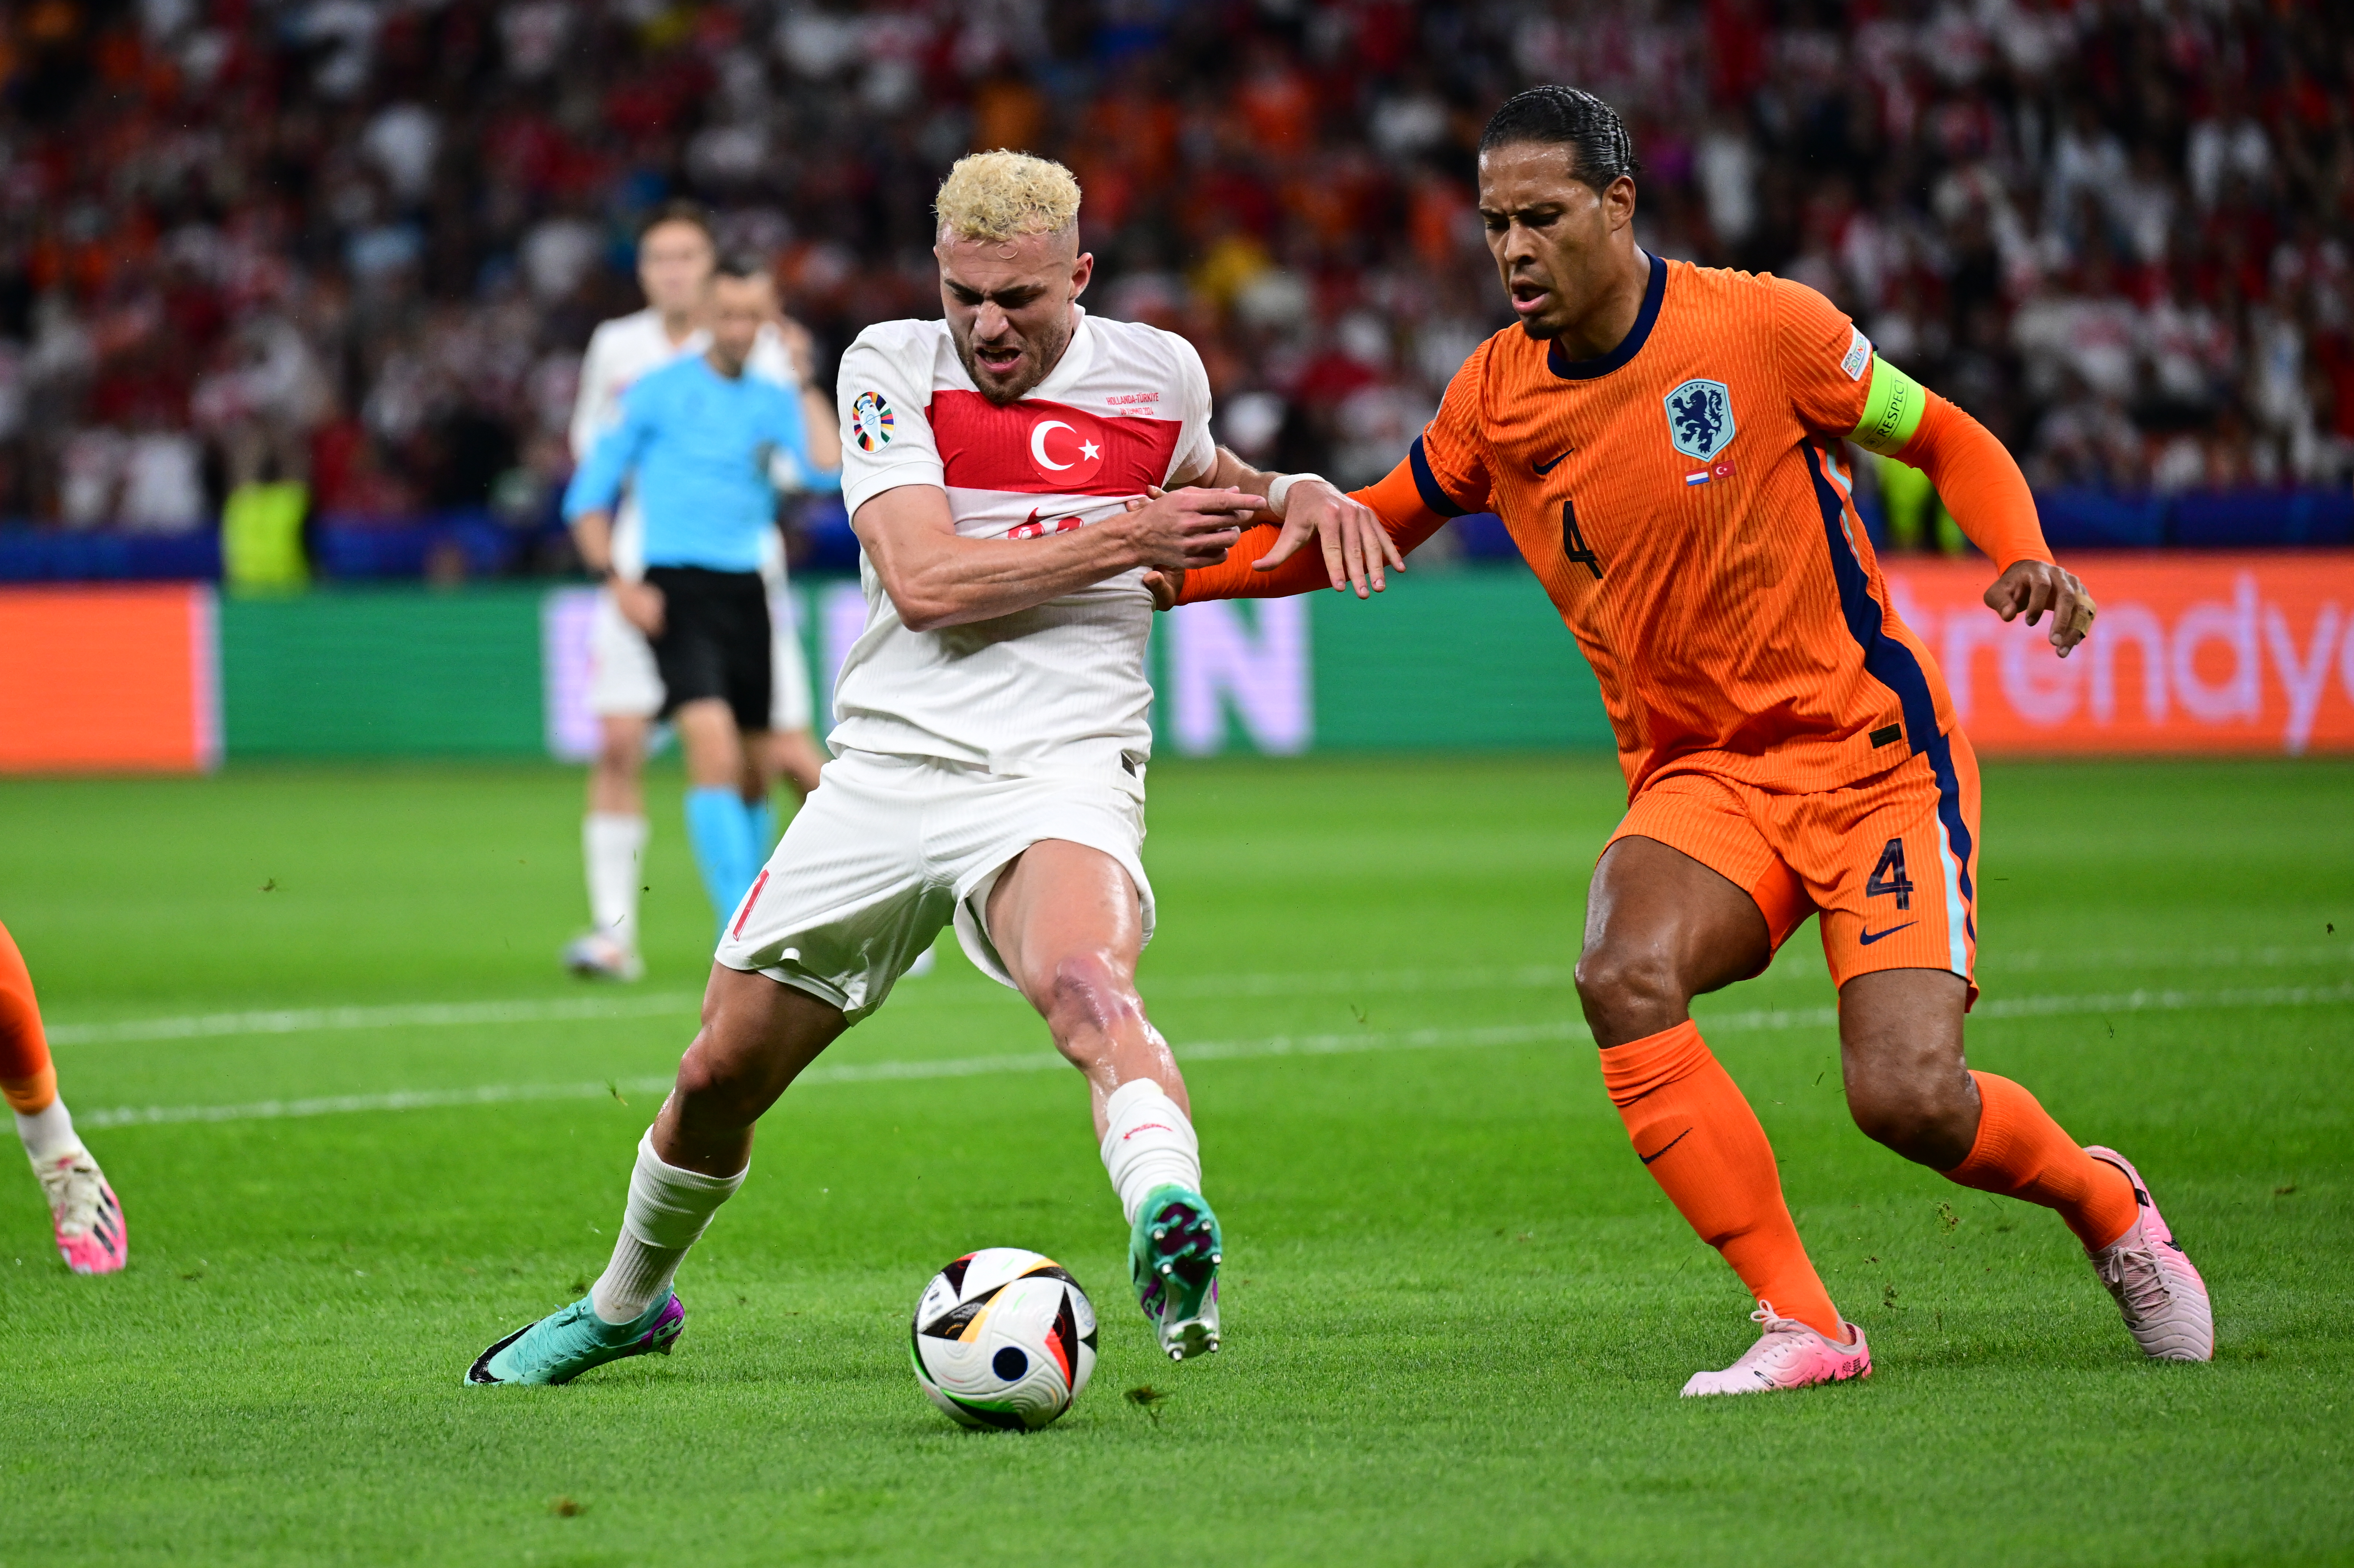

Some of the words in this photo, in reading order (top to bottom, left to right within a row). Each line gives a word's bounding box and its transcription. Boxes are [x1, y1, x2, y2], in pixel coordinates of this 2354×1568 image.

[1683, 385, 1704, 393] KNVB
[1843, 353, 1853, 368] UEFA
[1106, 392, 1159, 405] HOLLANDA-TÜRKİYE
[1877, 377, 1904, 437] RESPECT
[1563, 500, 1603, 580] 4
[1890, 571, 2354, 757] rendy
[1866, 838, 1914, 910] 4
